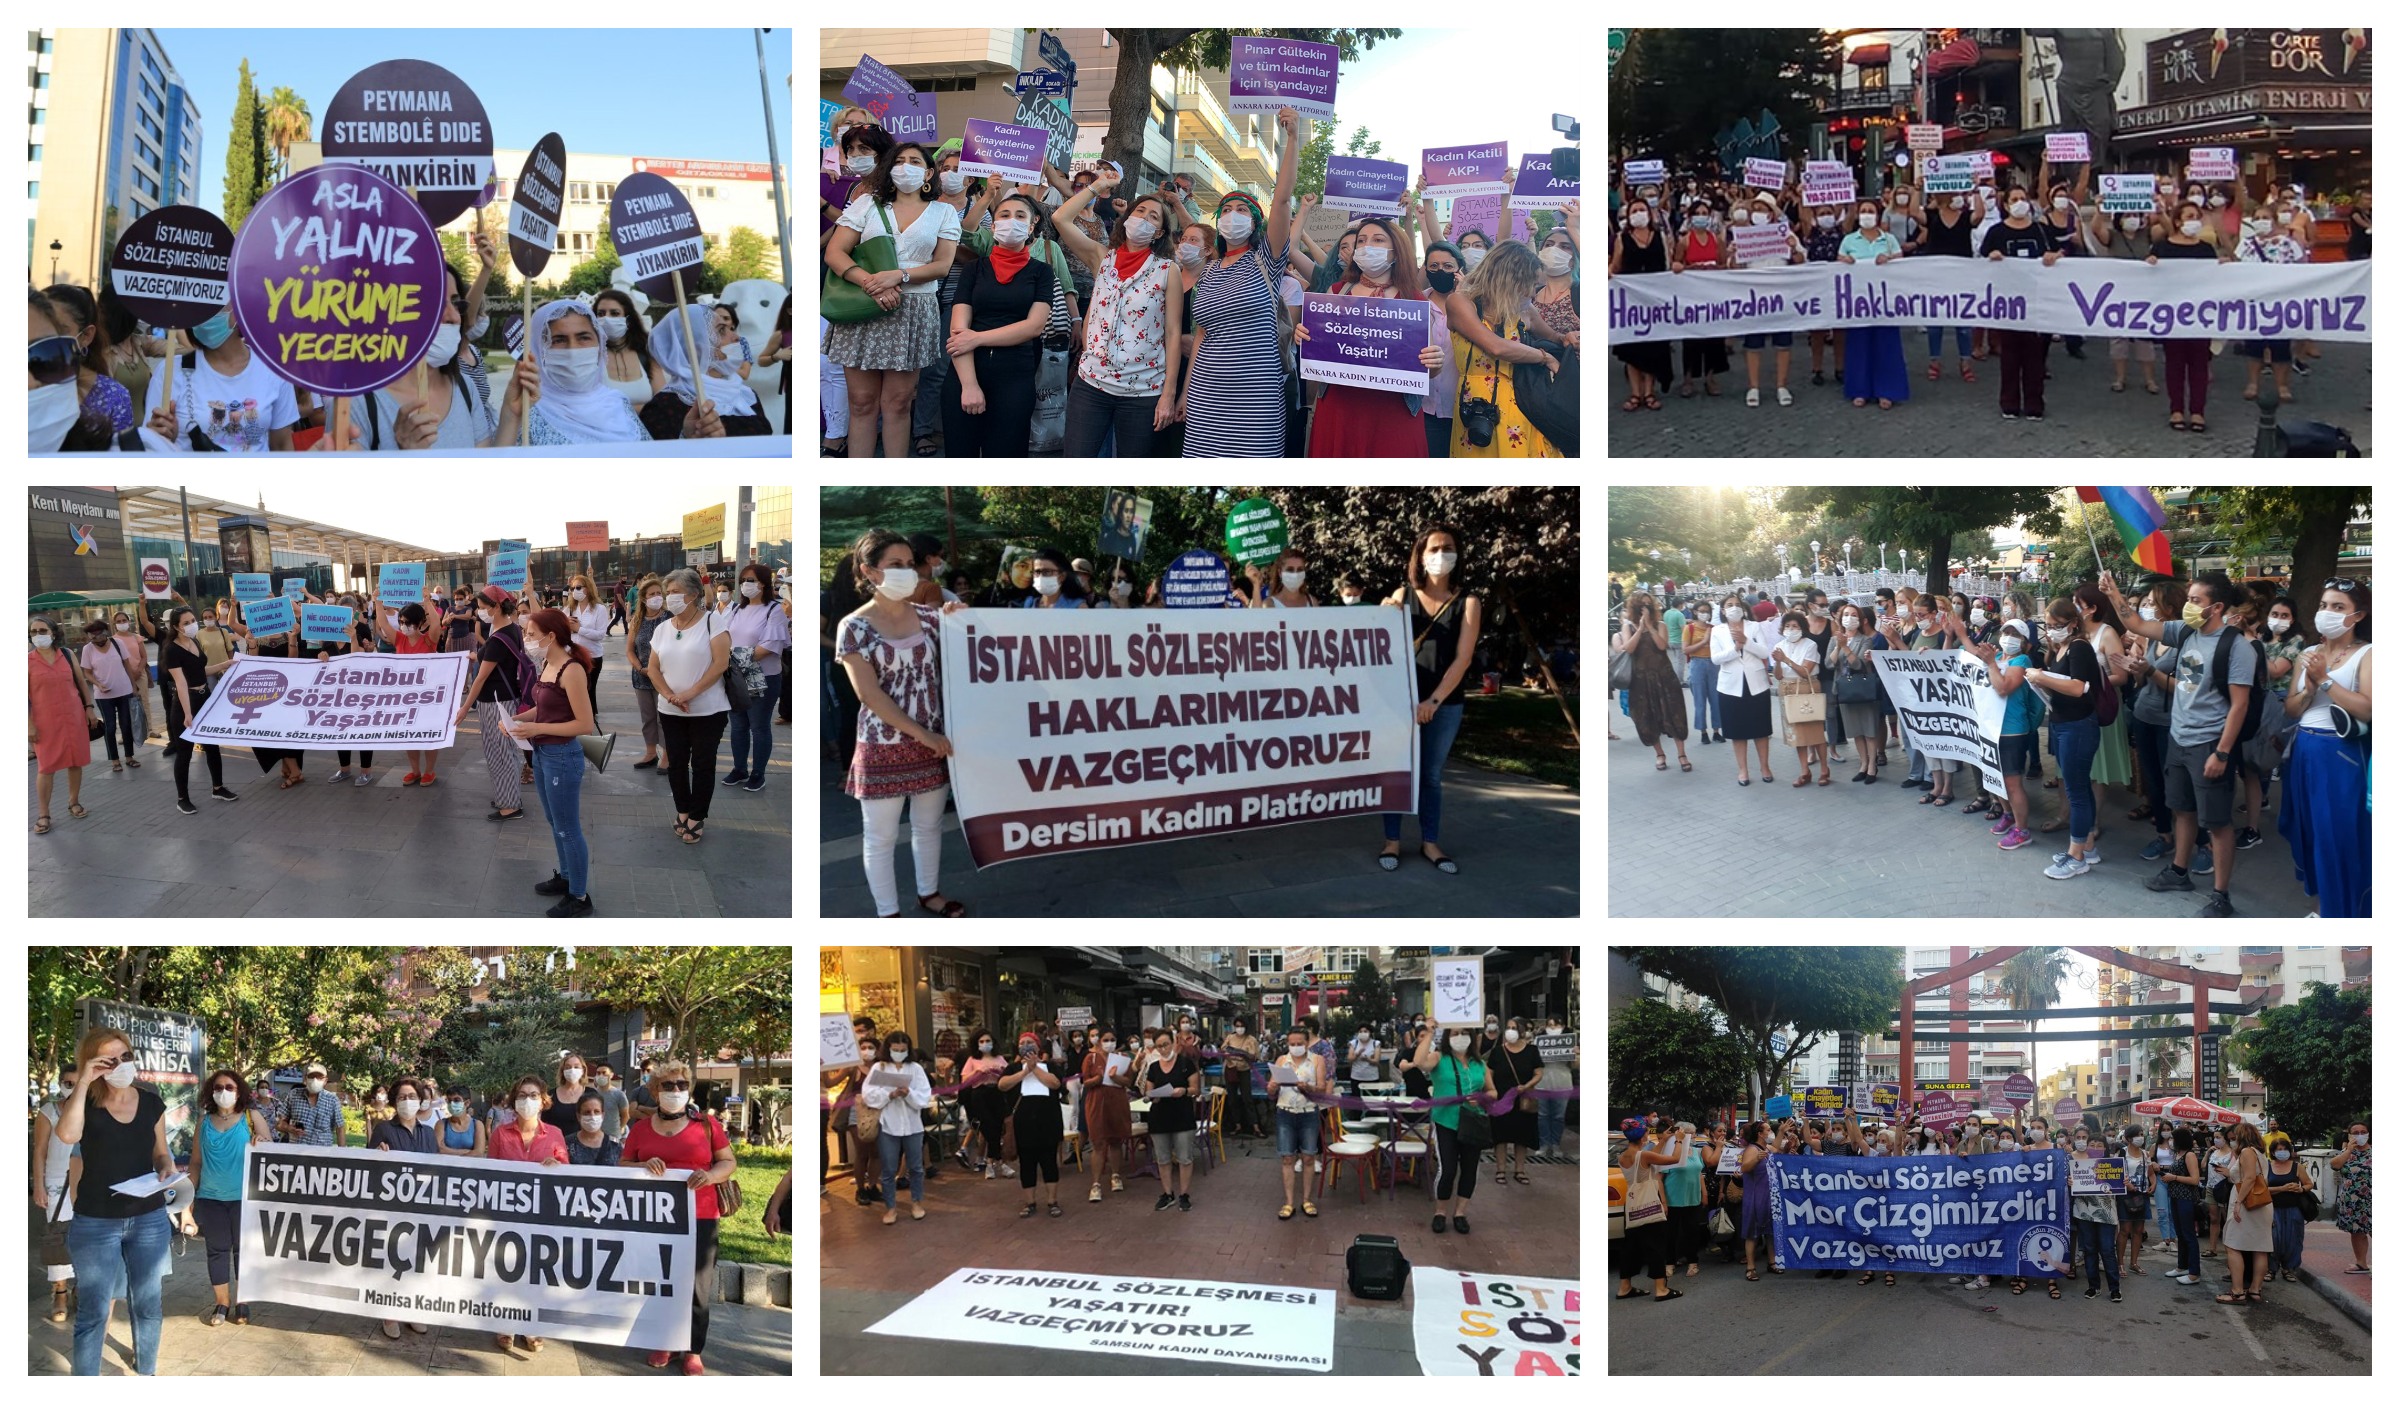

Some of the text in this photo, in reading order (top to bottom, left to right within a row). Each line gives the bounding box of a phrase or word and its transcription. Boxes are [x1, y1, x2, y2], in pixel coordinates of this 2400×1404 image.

[1245, 44, 1326, 60] Pınar Gültekin
[2270, 32, 2320, 49] CARTE
[1257, 62, 1280, 71] tüm
[1284, 63, 1330, 78] kadınlar
[2271, 50, 2335, 77] D'OR
[1240, 78, 1327, 94] için isyandayız!
[364, 90, 452, 112] PEYMANA
[2268, 88, 2347, 108] ENERJİ
[1031, 93, 1073, 138] KADIN
[1291, 105, 1331, 116] PLATFORMU
[334, 117, 482, 143] STEMBOLÊ DIDE
[994, 126, 1021, 136] Kadın
[974, 135, 1035, 151] Cinayetlerine
[975, 148, 1028, 162] Acil Önlem!
[1427, 148, 1502, 162] Kadın Katili
[534, 145, 563, 189] İSTANBUL
[961, 166, 1038, 181] ANKARA PLATFORMU
[1330, 168, 1405, 182] Kadın Cinayetleri
[1448, 166, 1479, 177] AKP!
[1345, 181, 1386, 191] Politiktir!
[312, 180, 383, 218] ASLA
[624, 192, 674, 216] PEYMANA
[155, 221, 214, 248] İSTANBUL
[519, 211, 549, 242] YAŞATIR
[617, 212, 694, 244] STEMBOLÊ DIDE
[271, 216, 418, 266] YALNIZ
[636, 241, 699, 277] JİYANKİRİN
[124, 275, 225, 300] VAZGEÇMİYORUZ
[264, 265, 421, 327] YÜRÜME
[1310, 302, 1422, 321] 6284 ve İstanbul
[2068, 282, 2366, 336] Vazgeçmiyoruz
[1325, 322, 1402, 340] Sözleşmesi
[279, 328, 408, 364] YECEKSİN
[1337, 343, 1388, 359] Yaşatır!
[1304, 367, 1424, 388] ANKARA KADIN PLATFORMU
[32, 494, 120, 519] Kent Meydanı AVM
[249, 601, 283, 613] KATLEDİLEN
[254, 612, 282, 623] KADINLAR
[966, 621, 1393, 683] İSTANBUL SÖZLEŞMESİ YAŞATIR
[314, 666, 426, 686] İstanbul
[1882, 656, 1943, 673] İSTANBUL
[235, 692, 279, 704] UYGULA
[283, 686, 446, 710] Sözleşmesi
[306, 708, 417, 731] Yaşatır!
[1028, 684, 1360, 737] HAKLARIMIZDAN
[199, 726, 441, 741] BURSA İSTANBUL SÖZLEŞMESİ KADIN İNİSİYATİFİ
[1936, 743, 1954, 752] Kadın
[1018, 730, 1371, 793] VAZGEÇMİYORUZ!
[1001, 786, 1382, 852] Dersim Kadın Platformu
[108, 1015, 192, 1039] BU PROJELER
[151, 1038, 192, 1053] ESERİN
[1807, 1094, 1843, 1103] Cinayetleri
[1927, 1097, 1946, 1105] PEYMANA
[1776, 1155, 2053, 1192] İstanbul Sözleşmesi
[258, 1157, 676, 1225] İSTANBUL SÖZLEŞMESİ YAŞATIR
[1784, 1188, 2057, 1238] Mor Çizgimizdir!
[2029, 1228, 2046, 1238] Kadın
[259, 1209, 674, 1298] VAZGEÇMİYORUZ..!
[1788, 1236, 2004, 1267] Vazgeçmiyoruz
[963, 1271, 1318, 1305] İSTANBUL SÖZLEŞMESİ
[364, 1288, 532, 1322] Manisa Kadın Platformu
[1047, 1296, 1192, 1317] YAŞATIR!
[963, 1305, 1255, 1338] VAZGEÇMİYORUZ
[1089, 1338, 1328, 1365] SAMSUN KADIN DAYANIŞMASI
